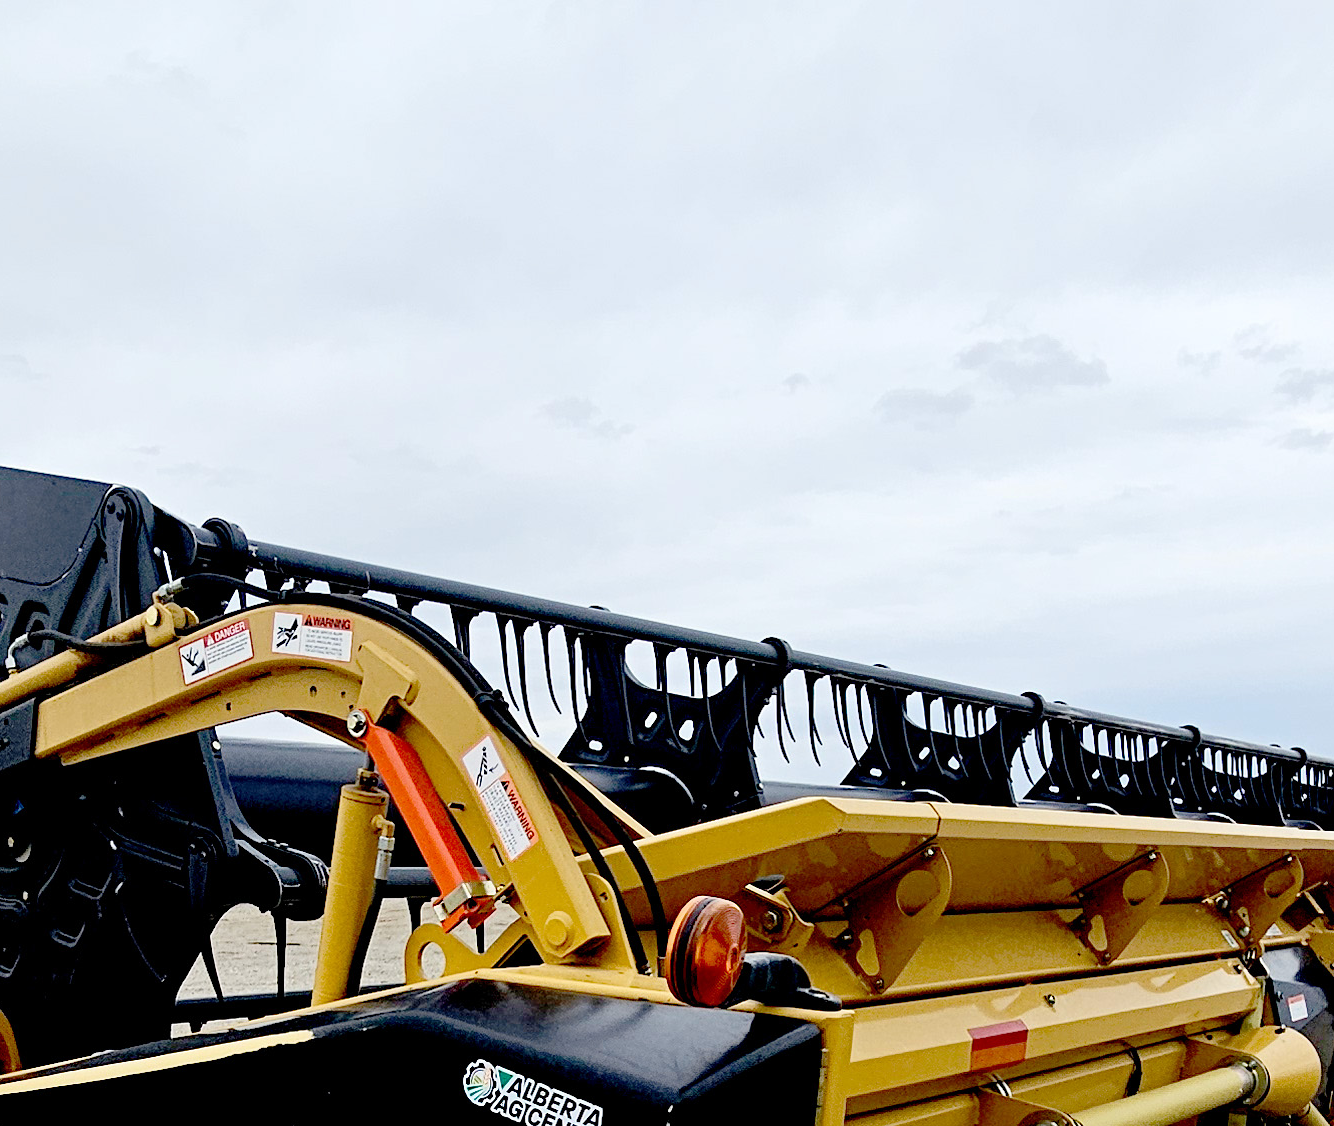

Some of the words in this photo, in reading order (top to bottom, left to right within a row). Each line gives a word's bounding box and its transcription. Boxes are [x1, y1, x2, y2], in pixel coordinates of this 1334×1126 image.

[214, 621, 246, 643] DANGER
[313, 616, 351, 630] WARNING
[508, 788, 535, 841] WARNING
[494, 1095, 524, 1119] AG
